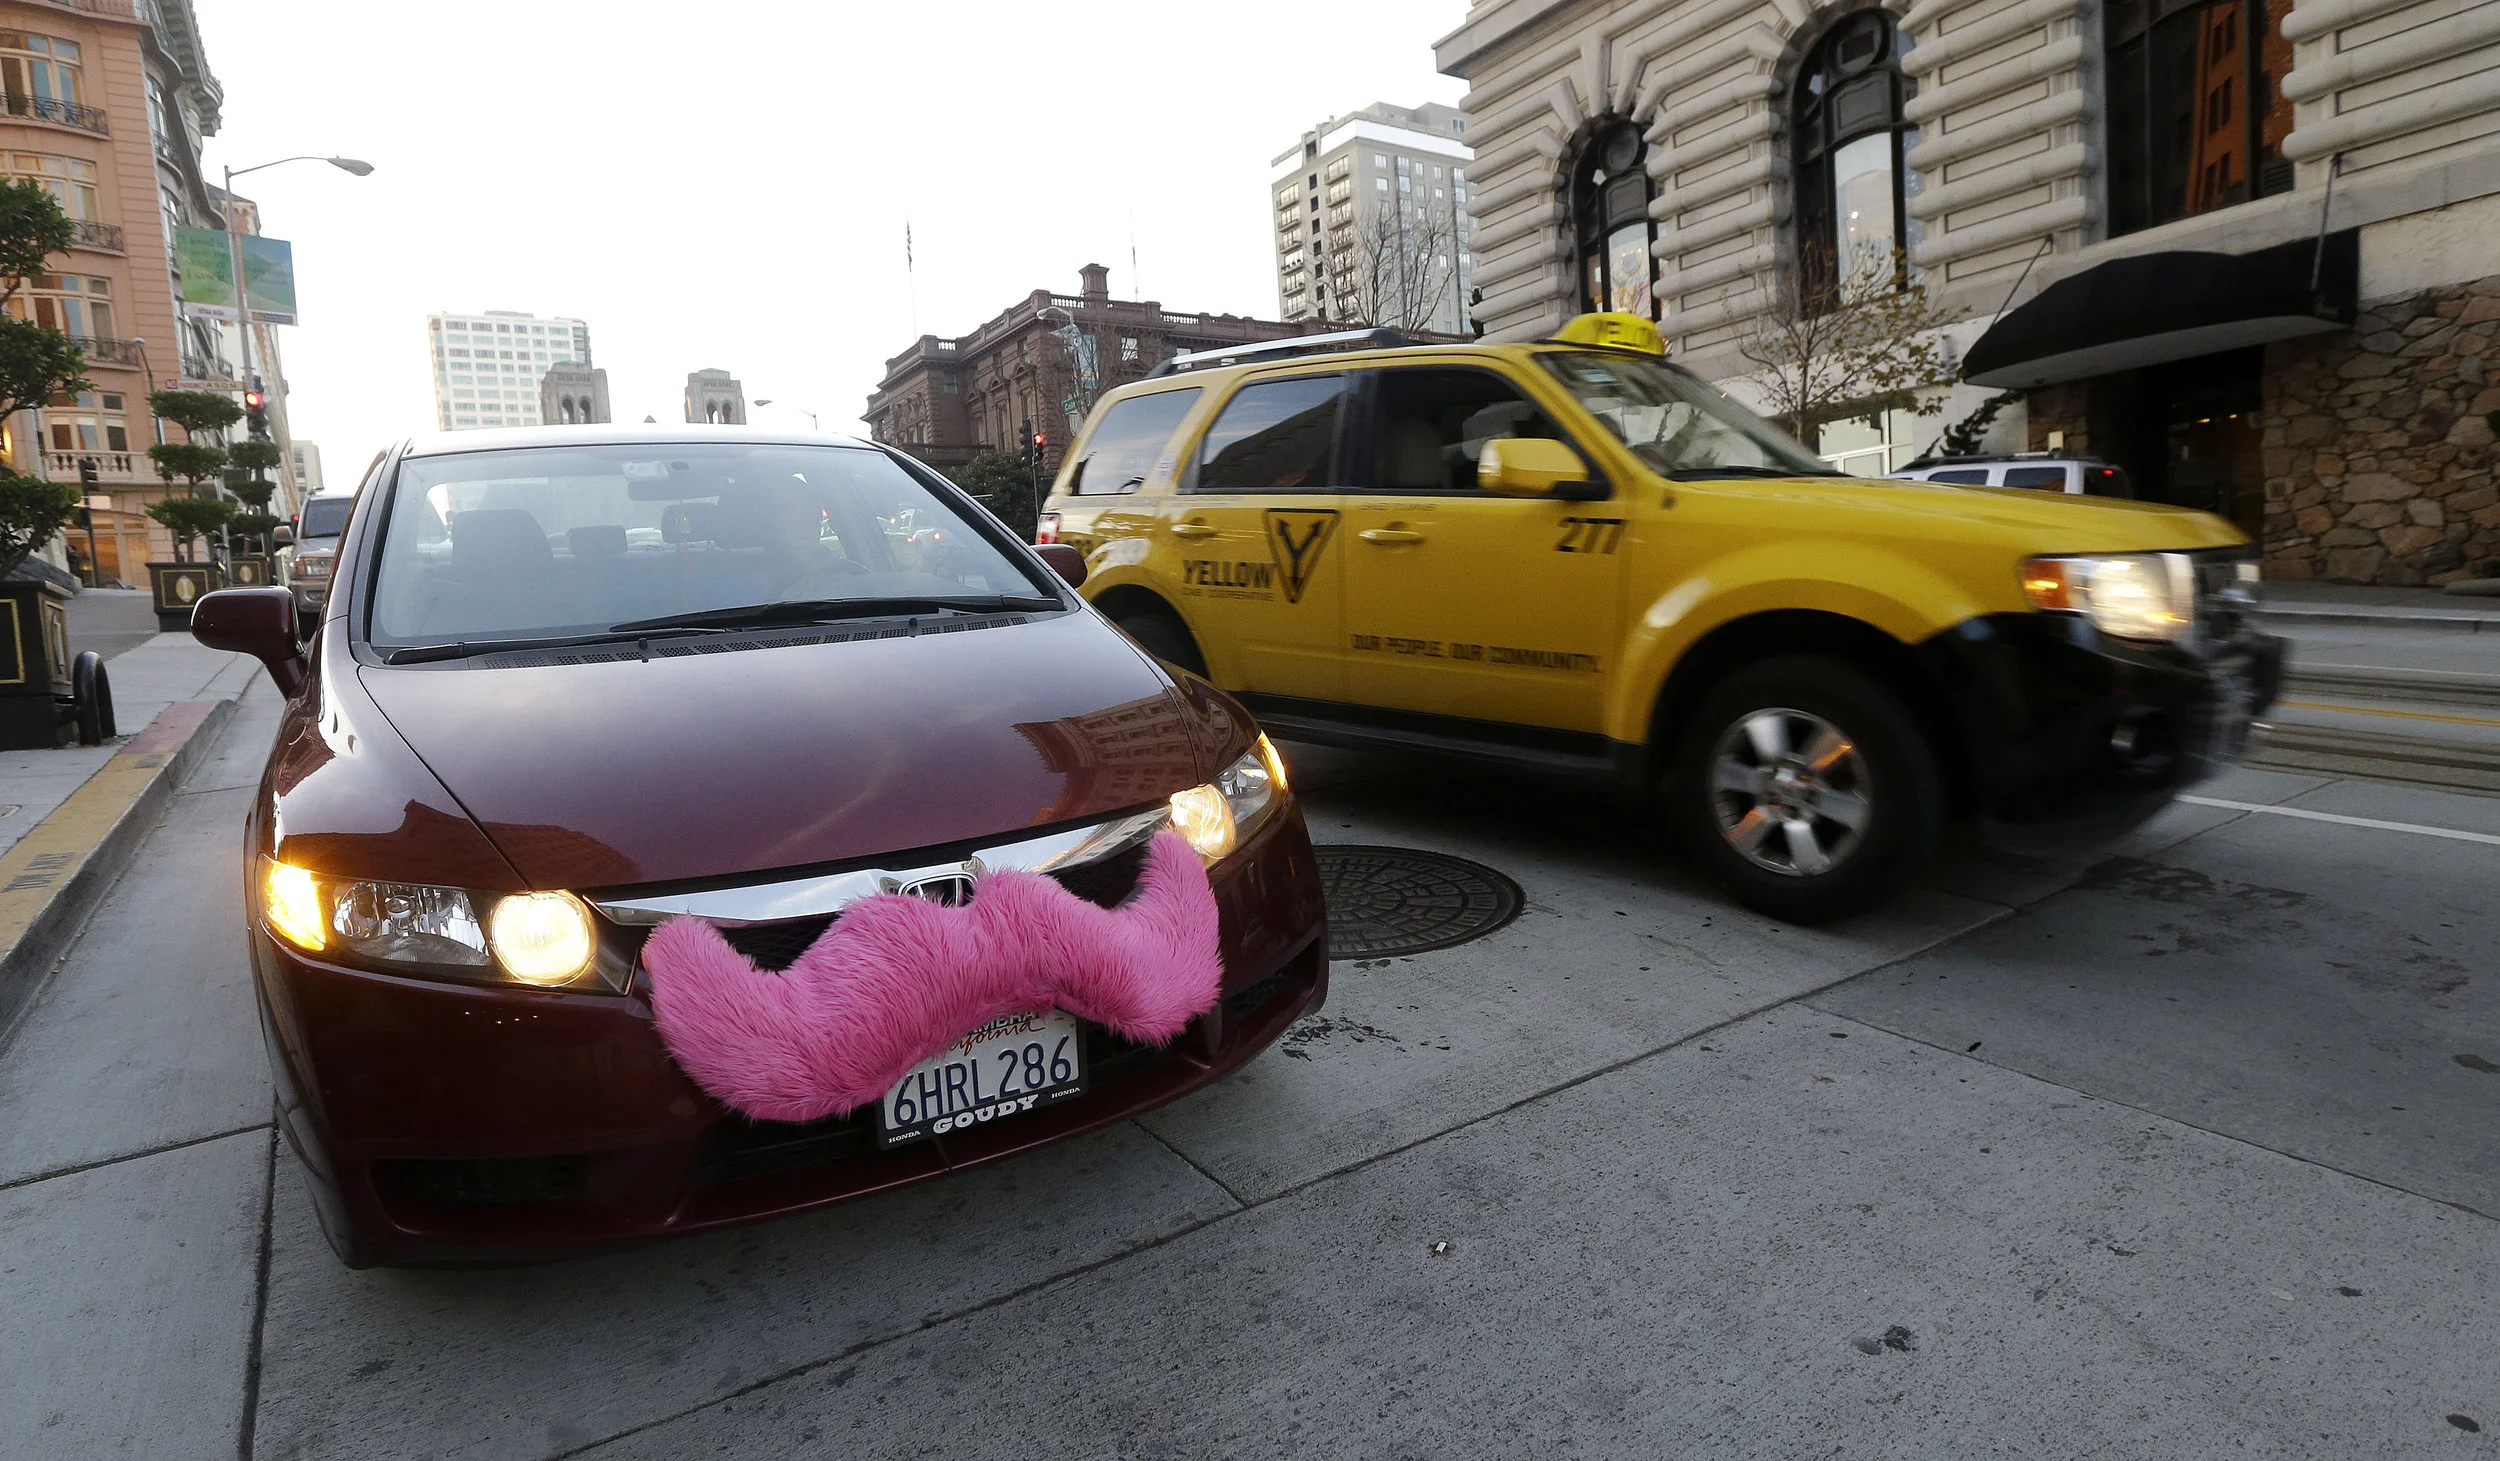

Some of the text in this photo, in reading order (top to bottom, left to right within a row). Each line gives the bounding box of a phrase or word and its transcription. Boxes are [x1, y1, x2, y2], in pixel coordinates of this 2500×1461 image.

[1554, 516, 1628, 555] 277
[1182, 559, 1278, 589] YELLOW
[893, 1034, 1072, 1126] 6HRL286
[888, 1087, 1081, 1144] HONDA GOUDY HONDA
